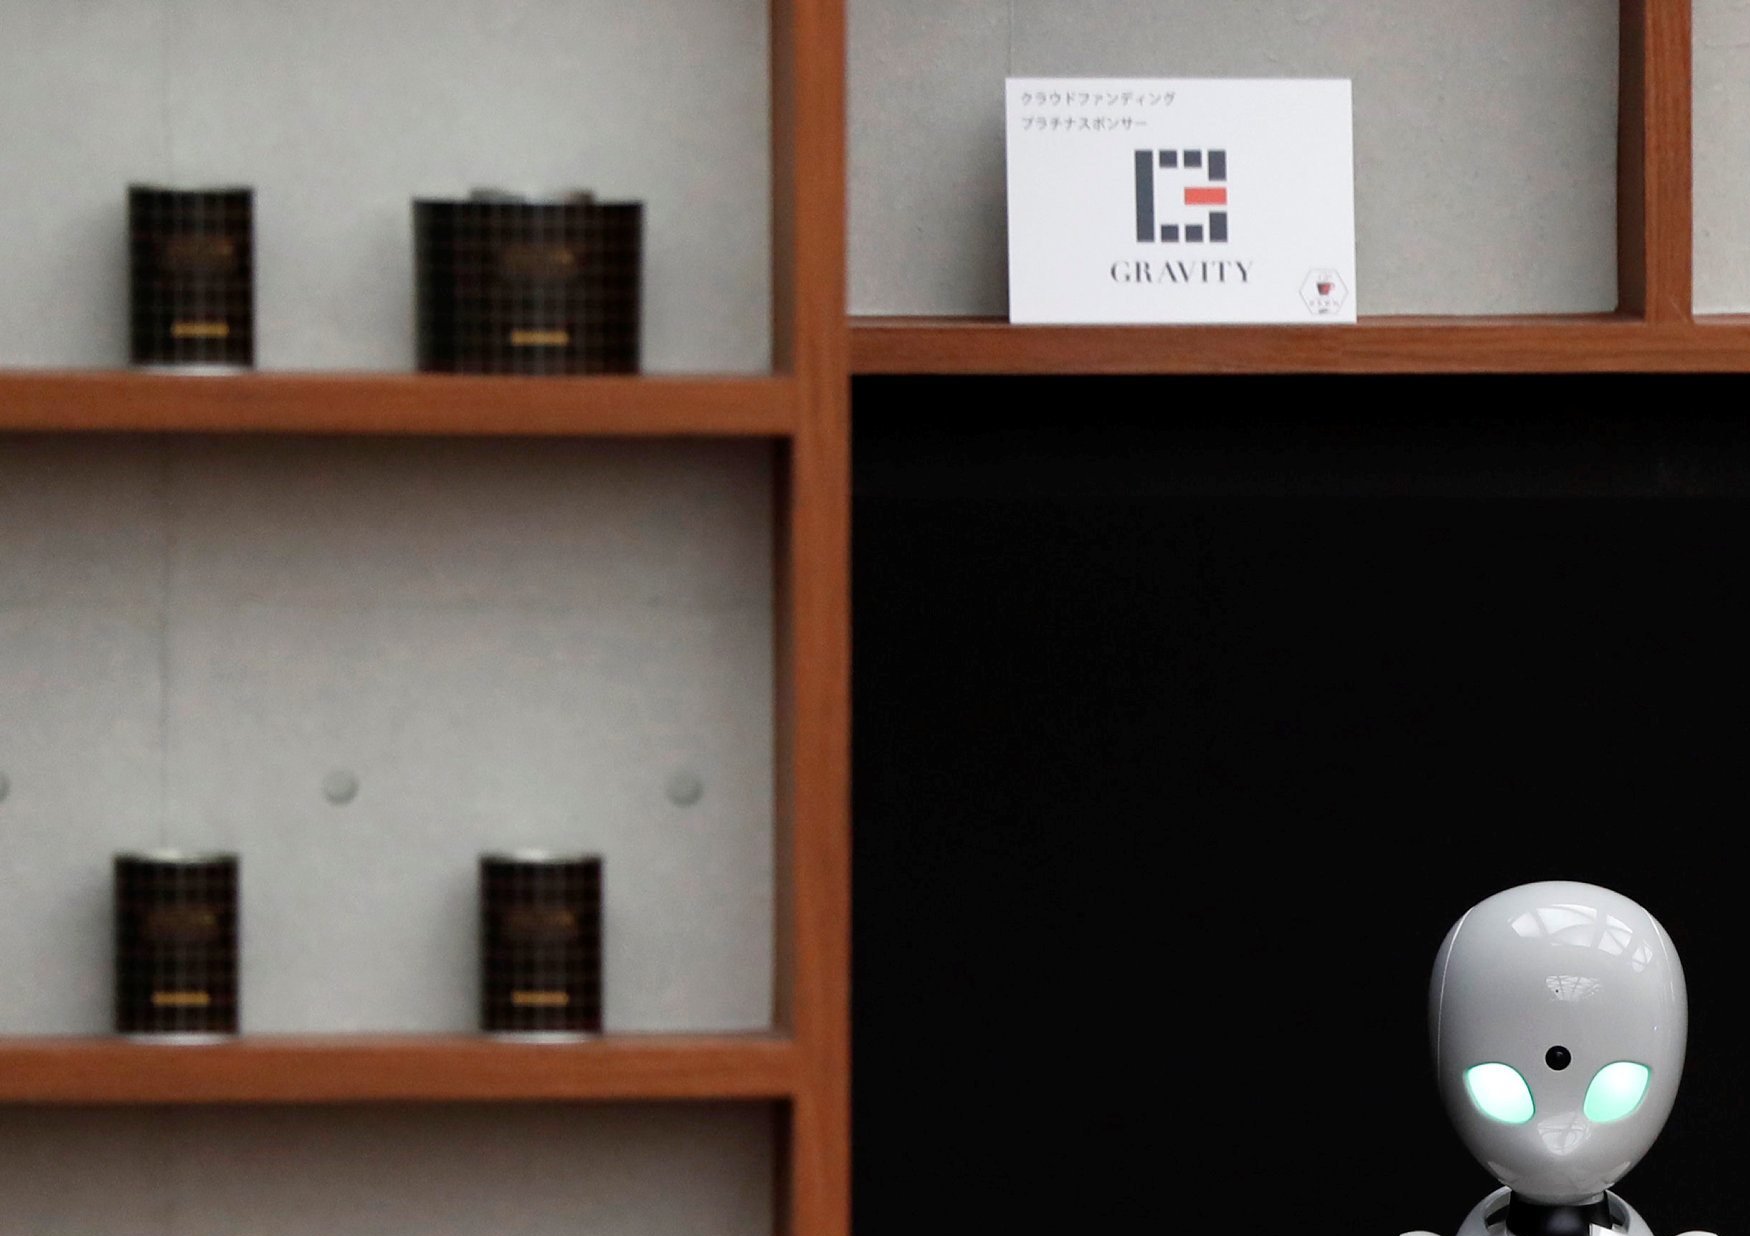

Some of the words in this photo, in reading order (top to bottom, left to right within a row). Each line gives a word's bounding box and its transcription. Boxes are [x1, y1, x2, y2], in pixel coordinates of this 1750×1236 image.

[1020, 90, 1176, 107] クラウドファンディング
[1021, 115, 1148, 131] プラチナスポンサー
[1110, 260, 1254, 284] GRAVITY
